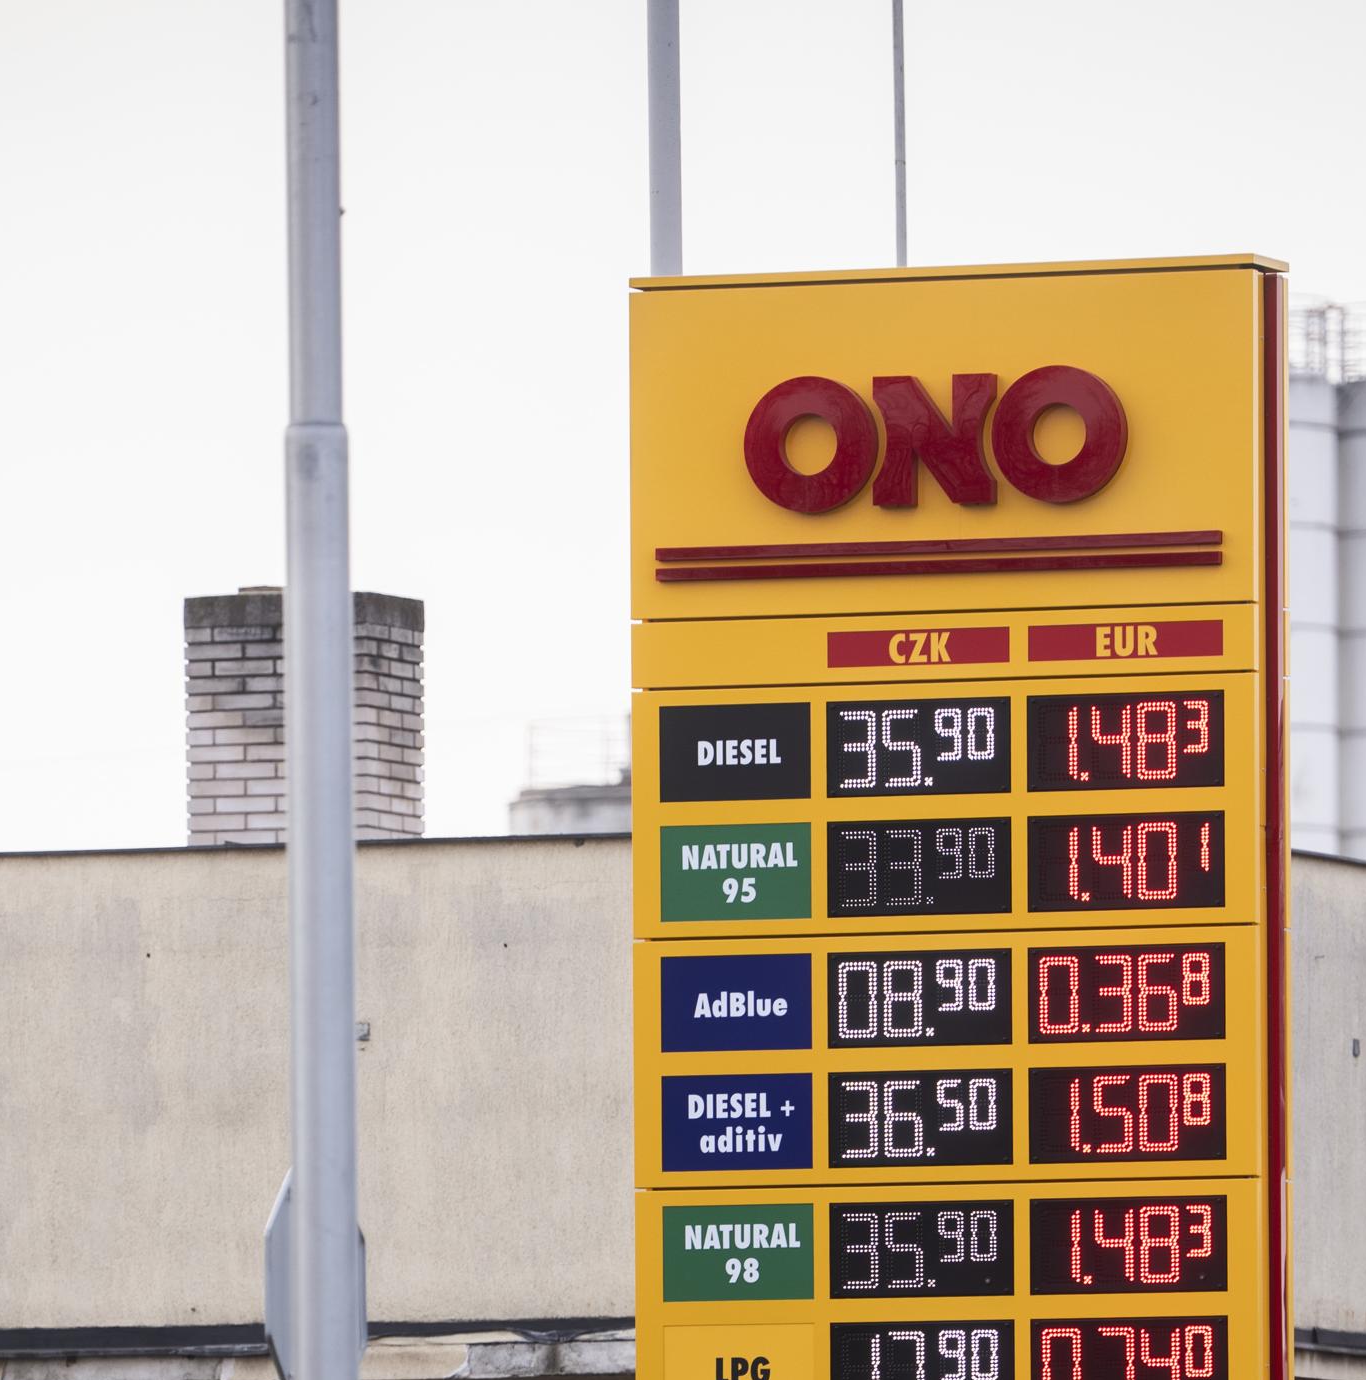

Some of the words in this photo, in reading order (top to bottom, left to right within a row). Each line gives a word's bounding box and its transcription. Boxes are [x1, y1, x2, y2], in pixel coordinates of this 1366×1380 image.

[743, 365, 1128, 515] ONO
[888, 631, 951, 664] CZK
[1095, 624, 1158, 658] EUR
[697, 738, 782, 767] DIESEL
[839, 706, 995, 789] 35.90
[1068, 699, 1209, 783] 1.483
[681, 841, 798, 871] NATURAL
[722, 877, 757, 904] 95
[841, 826, 995, 908] 33.90
[1068, 821, 1210, 903] 1.401
[694, 991, 788, 1019] AdBlue
[837, 958, 996, 1040] 08.90
[1038, 952, 1210, 1035] 0.368
[687, 1092, 772, 1121] DIESEL
[780, 1100, 795, 1117] +
[699, 1125, 782, 1154] aditiv
[841, 1078, 997, 1159] 36.50
[1070, 1072, 1211, 1154] 1.508
[684, 1223, 801, 1251] NATURAL
[724, 1257, 760, 1284] 98
[841, 1210, 997, 1291] 35.90
[1070, 1204, 1212, 1287] 1.483
